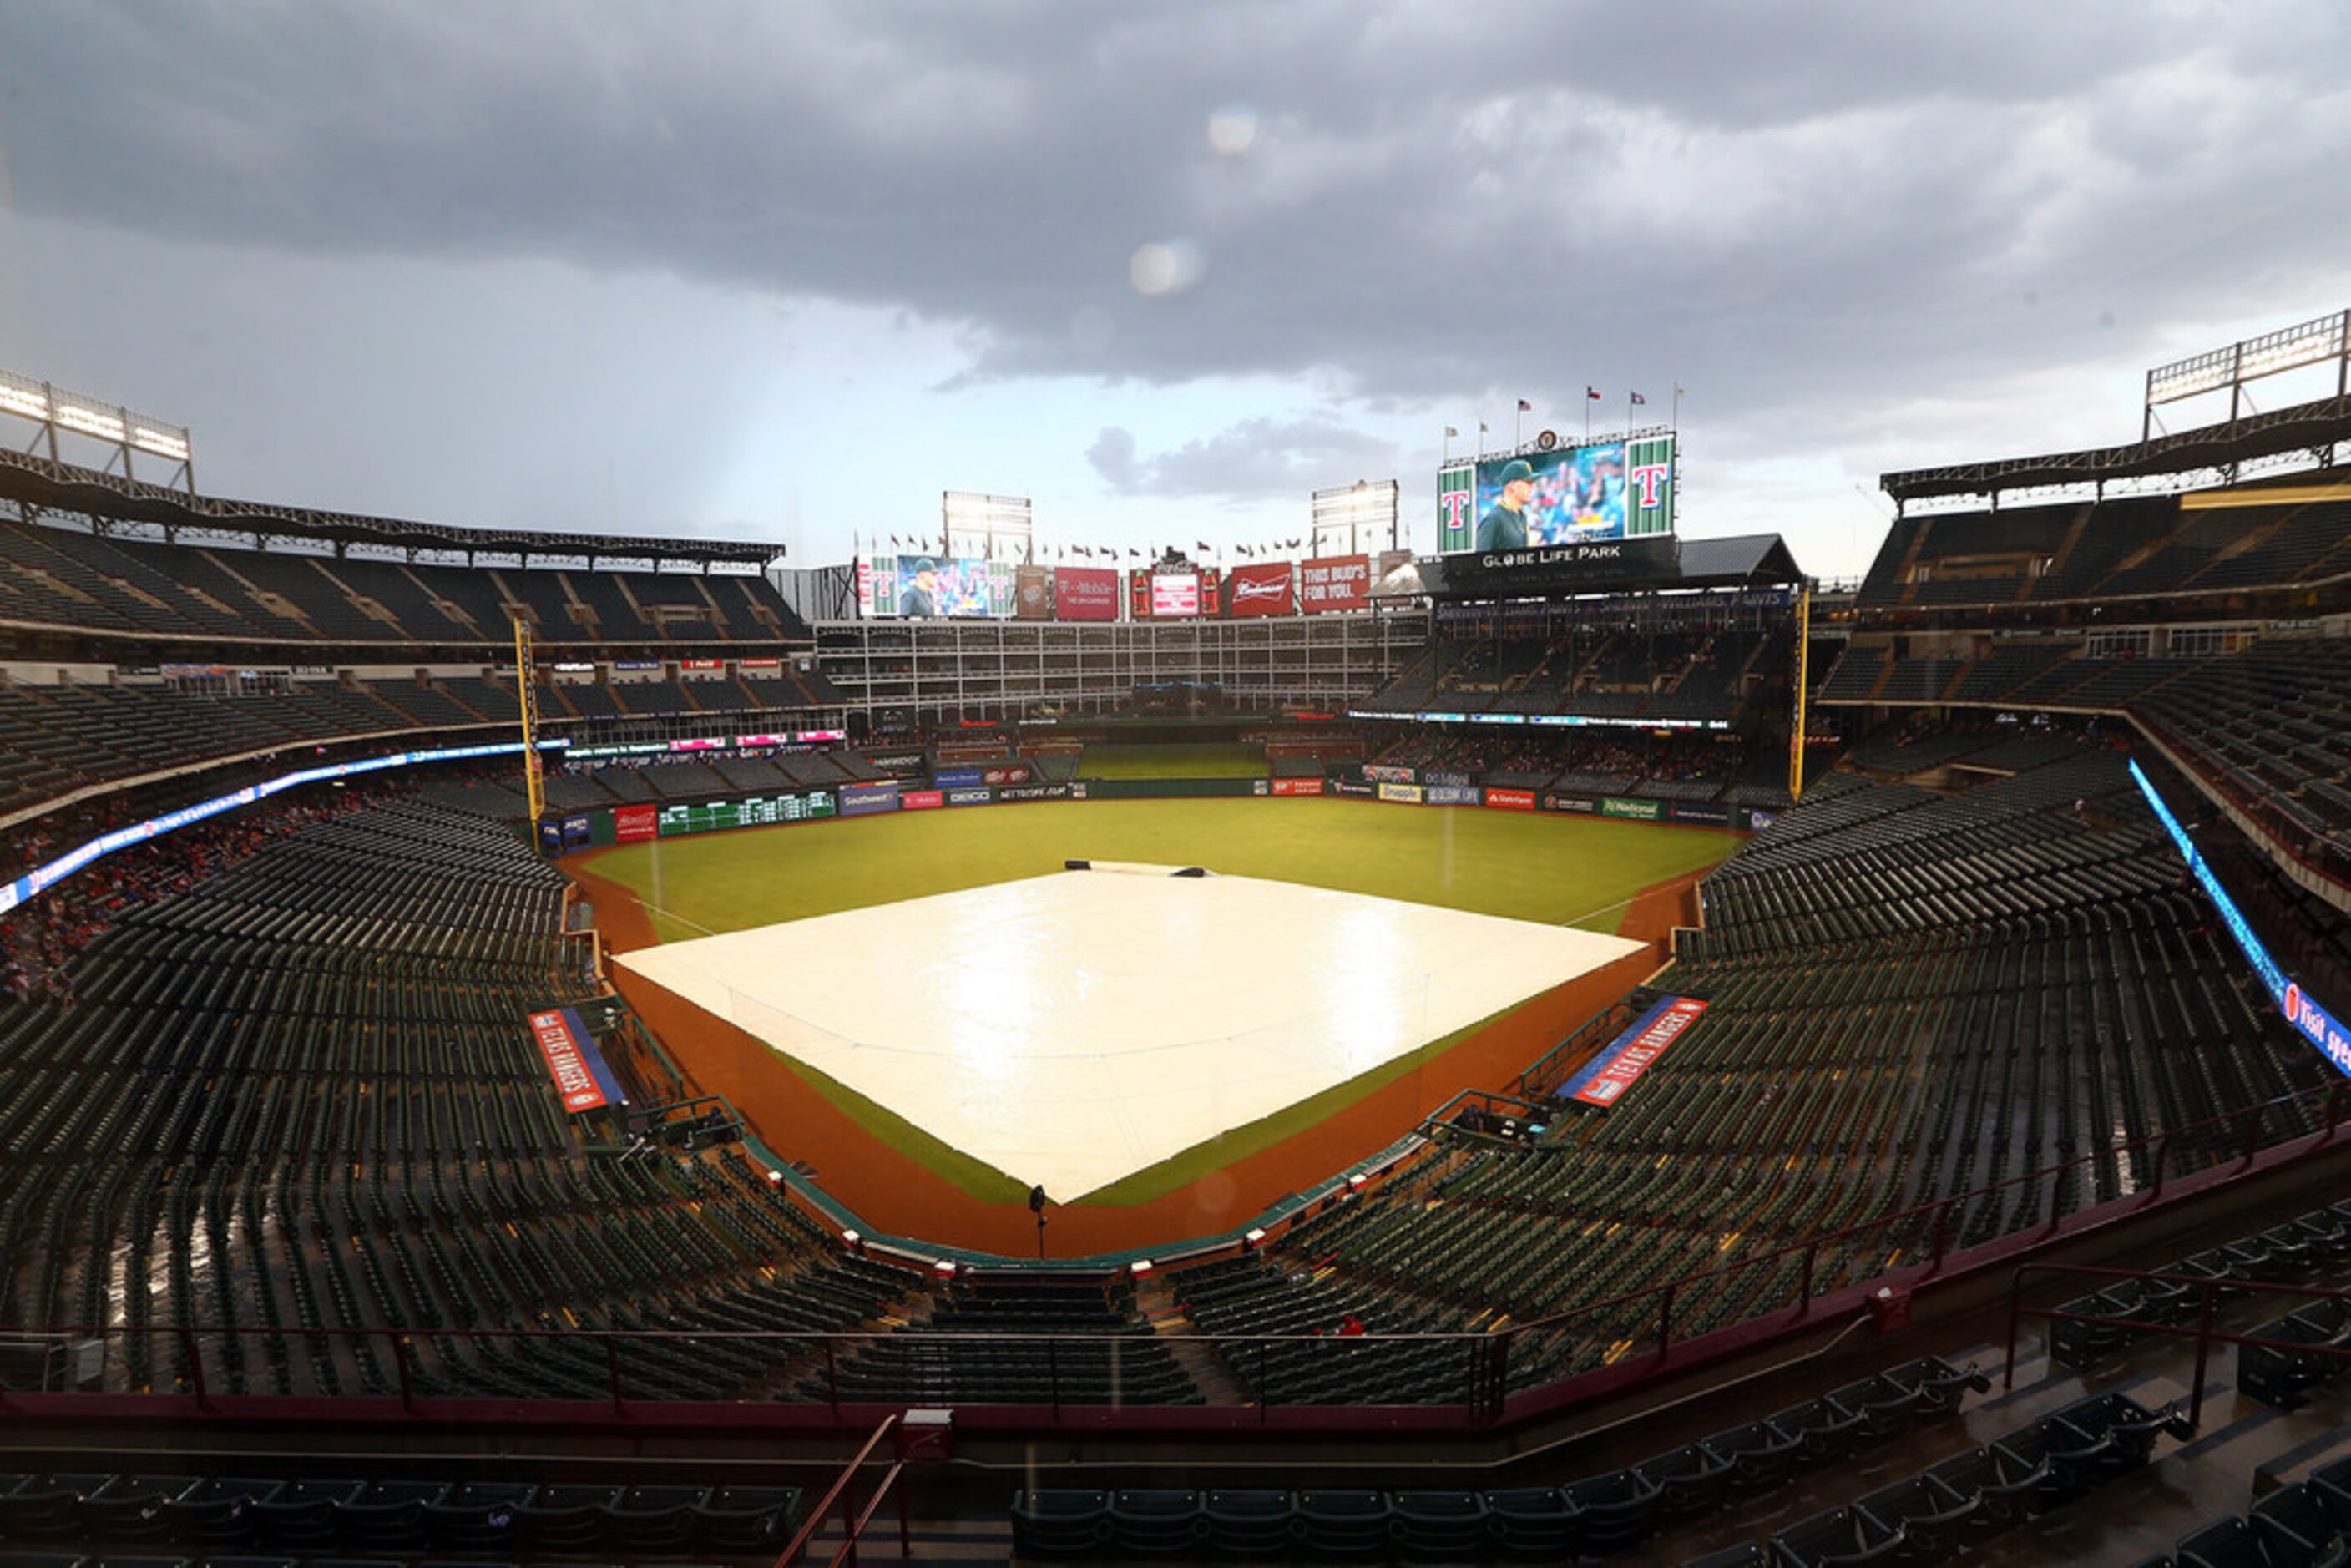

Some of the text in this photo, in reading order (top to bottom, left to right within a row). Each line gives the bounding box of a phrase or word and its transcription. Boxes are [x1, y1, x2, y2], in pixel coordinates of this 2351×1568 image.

[1482, 545, 1620, 568] GLOBE LIFE PARK
[1304, 564, 1367, 584] THIS BUD'S
[1304, 584, 1326, 601] FOR
[2299, 999, 2327, 1043] Visit
